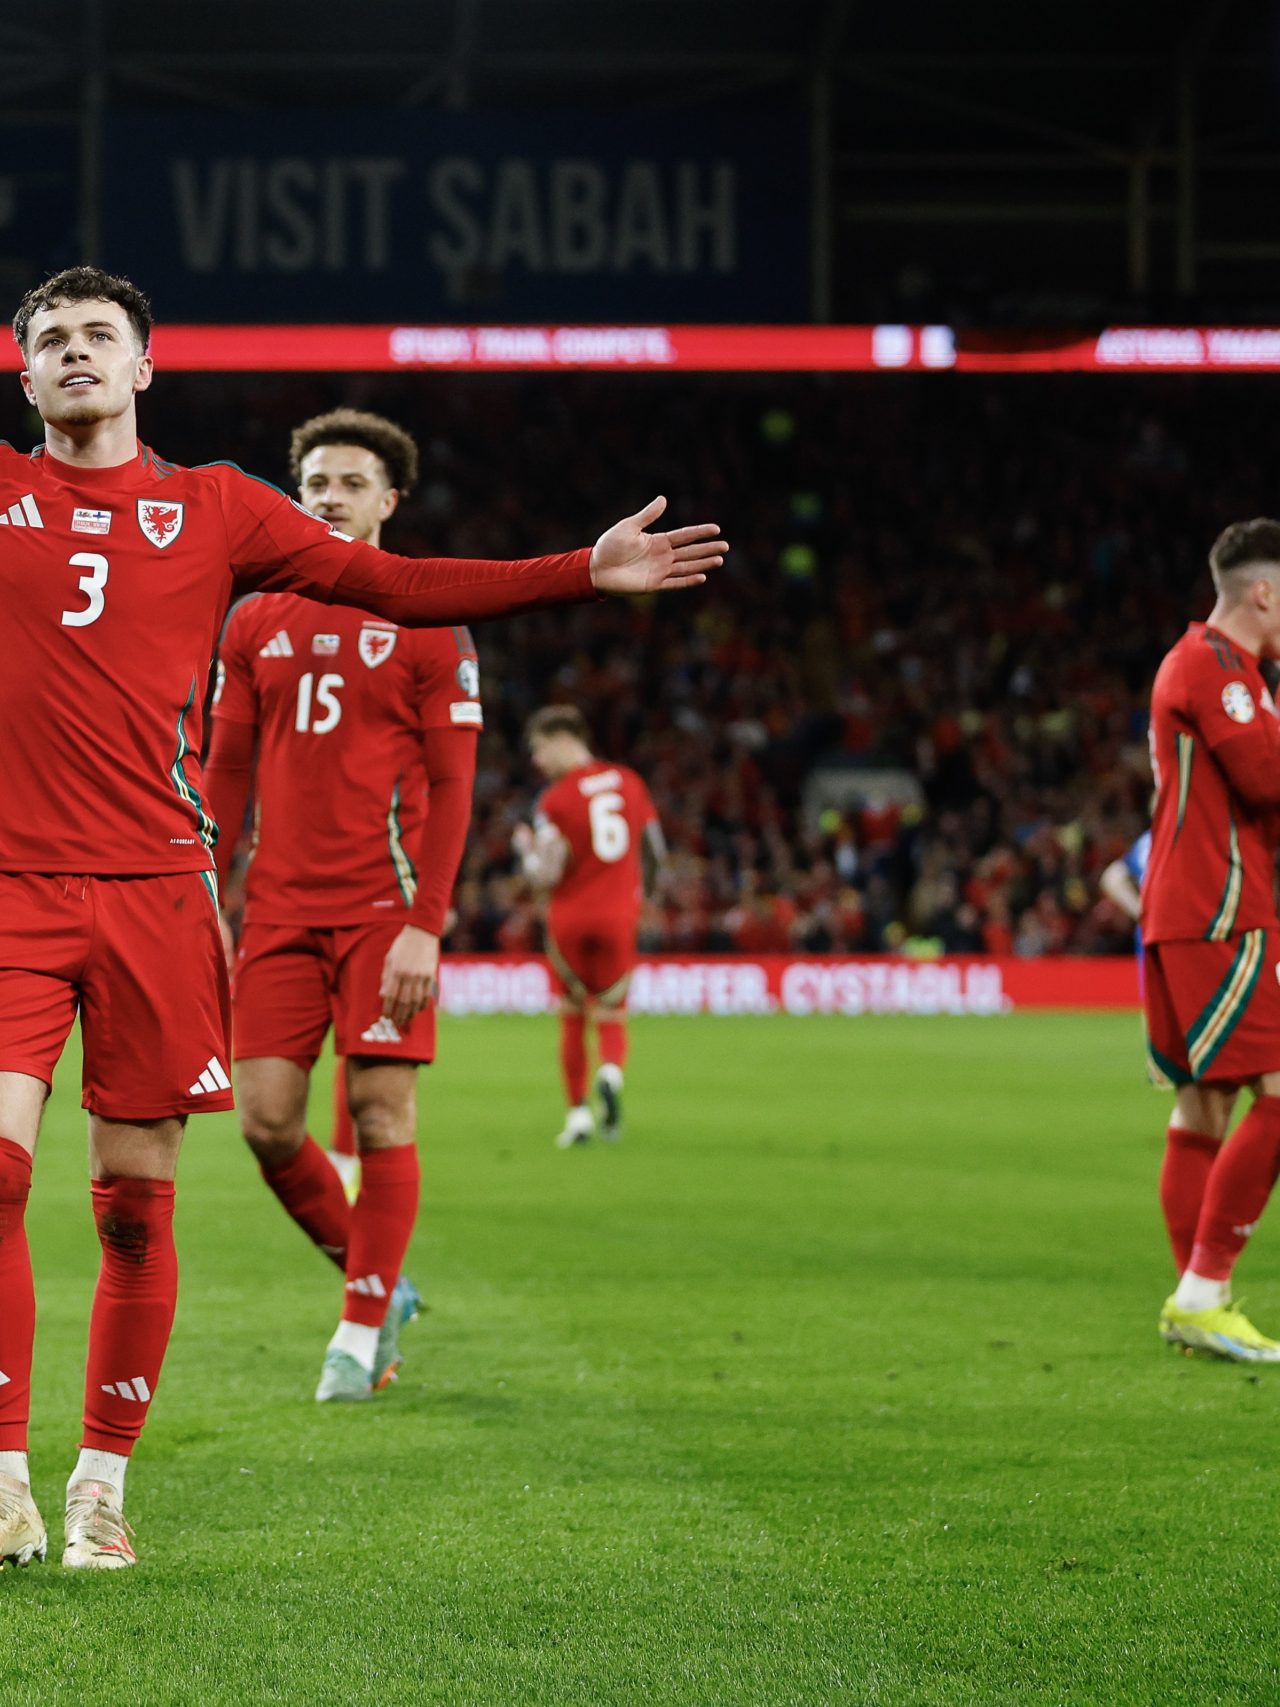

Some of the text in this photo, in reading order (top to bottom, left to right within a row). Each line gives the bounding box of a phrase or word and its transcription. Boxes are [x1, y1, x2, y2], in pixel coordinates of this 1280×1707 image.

[170, 157, 737, 274] VISIT SABAH
[61, 552, 109, 628] 3
[295, 672, 345, 735] 15
[589, 791, 630, 864] 6
